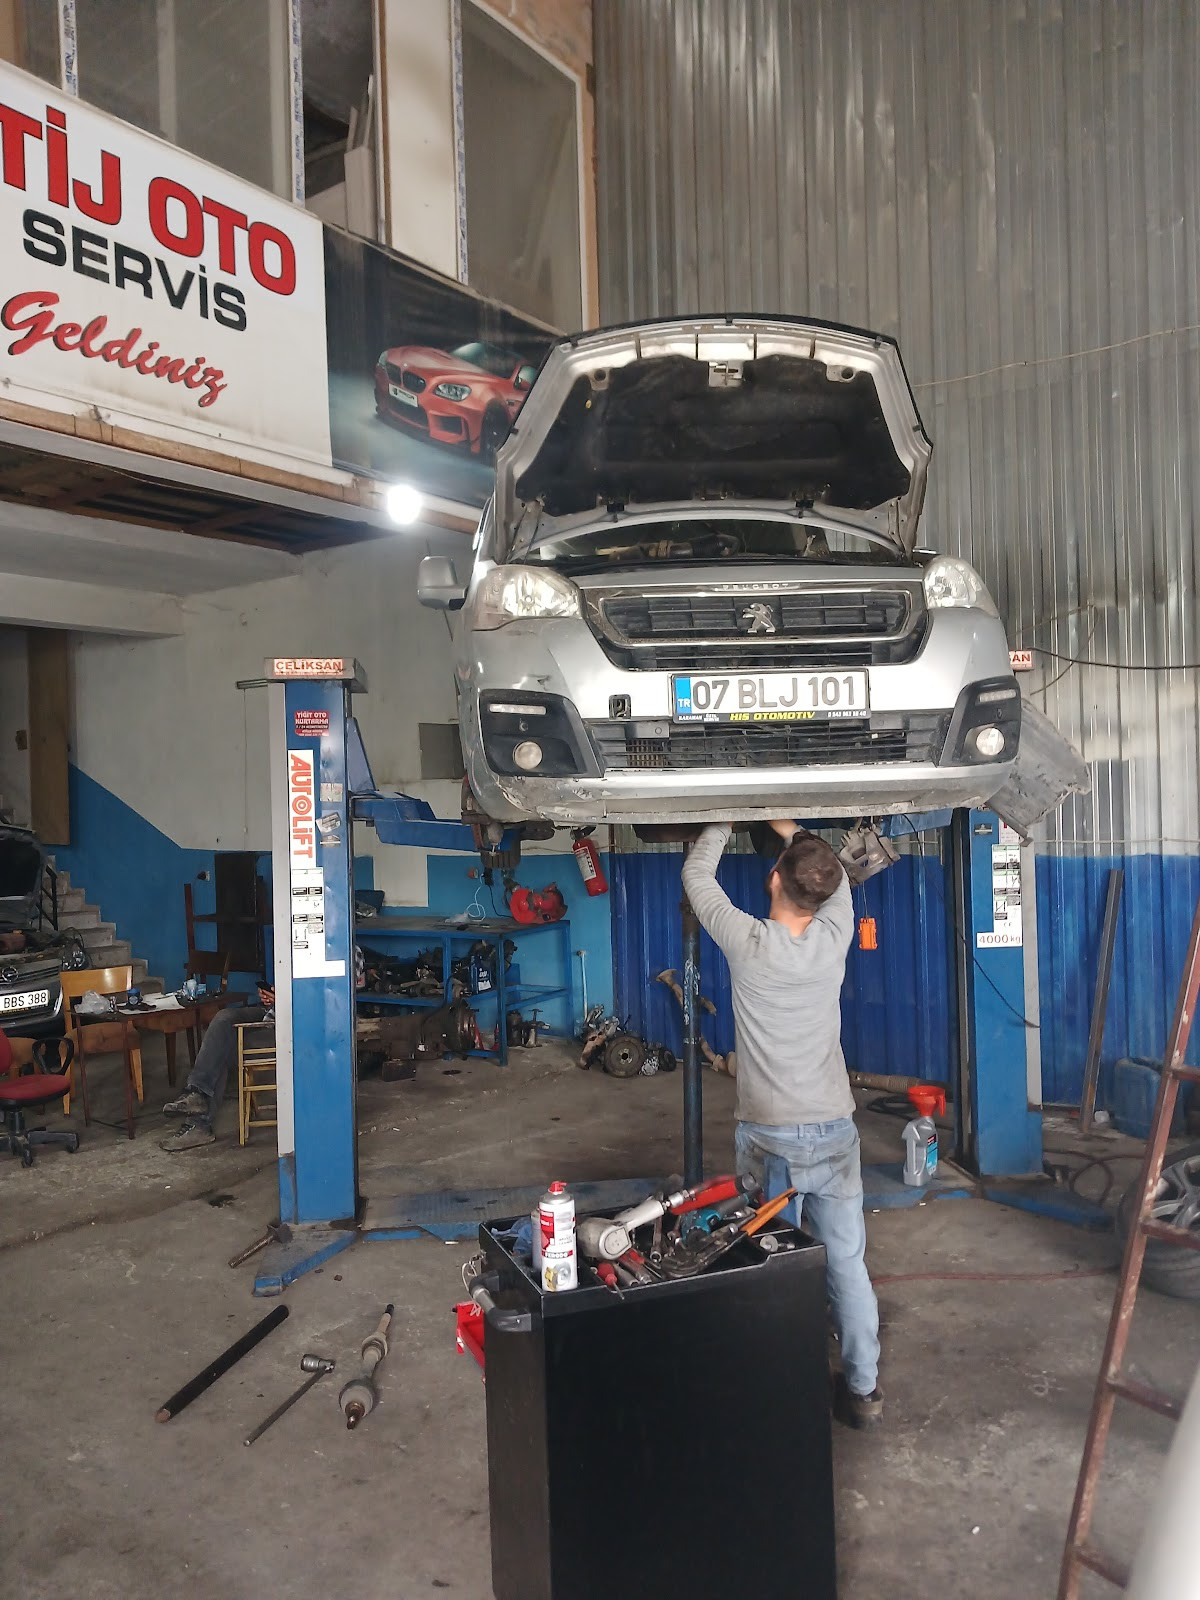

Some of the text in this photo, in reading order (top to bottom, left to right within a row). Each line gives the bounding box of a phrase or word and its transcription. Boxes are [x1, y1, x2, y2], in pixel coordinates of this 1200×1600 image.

[148, 176, 297, 296] OTO
[23, 208, 248, 332] SERVİS
[1, 290, 228, 408] Geldiniz
[678, 698, 691, 708] TR
[692, 676, 855, 710] 07 BLJ 101
[979, 934, 1021, 945] 4000 kg
[4, 992, 46, 1008] BBS 388
